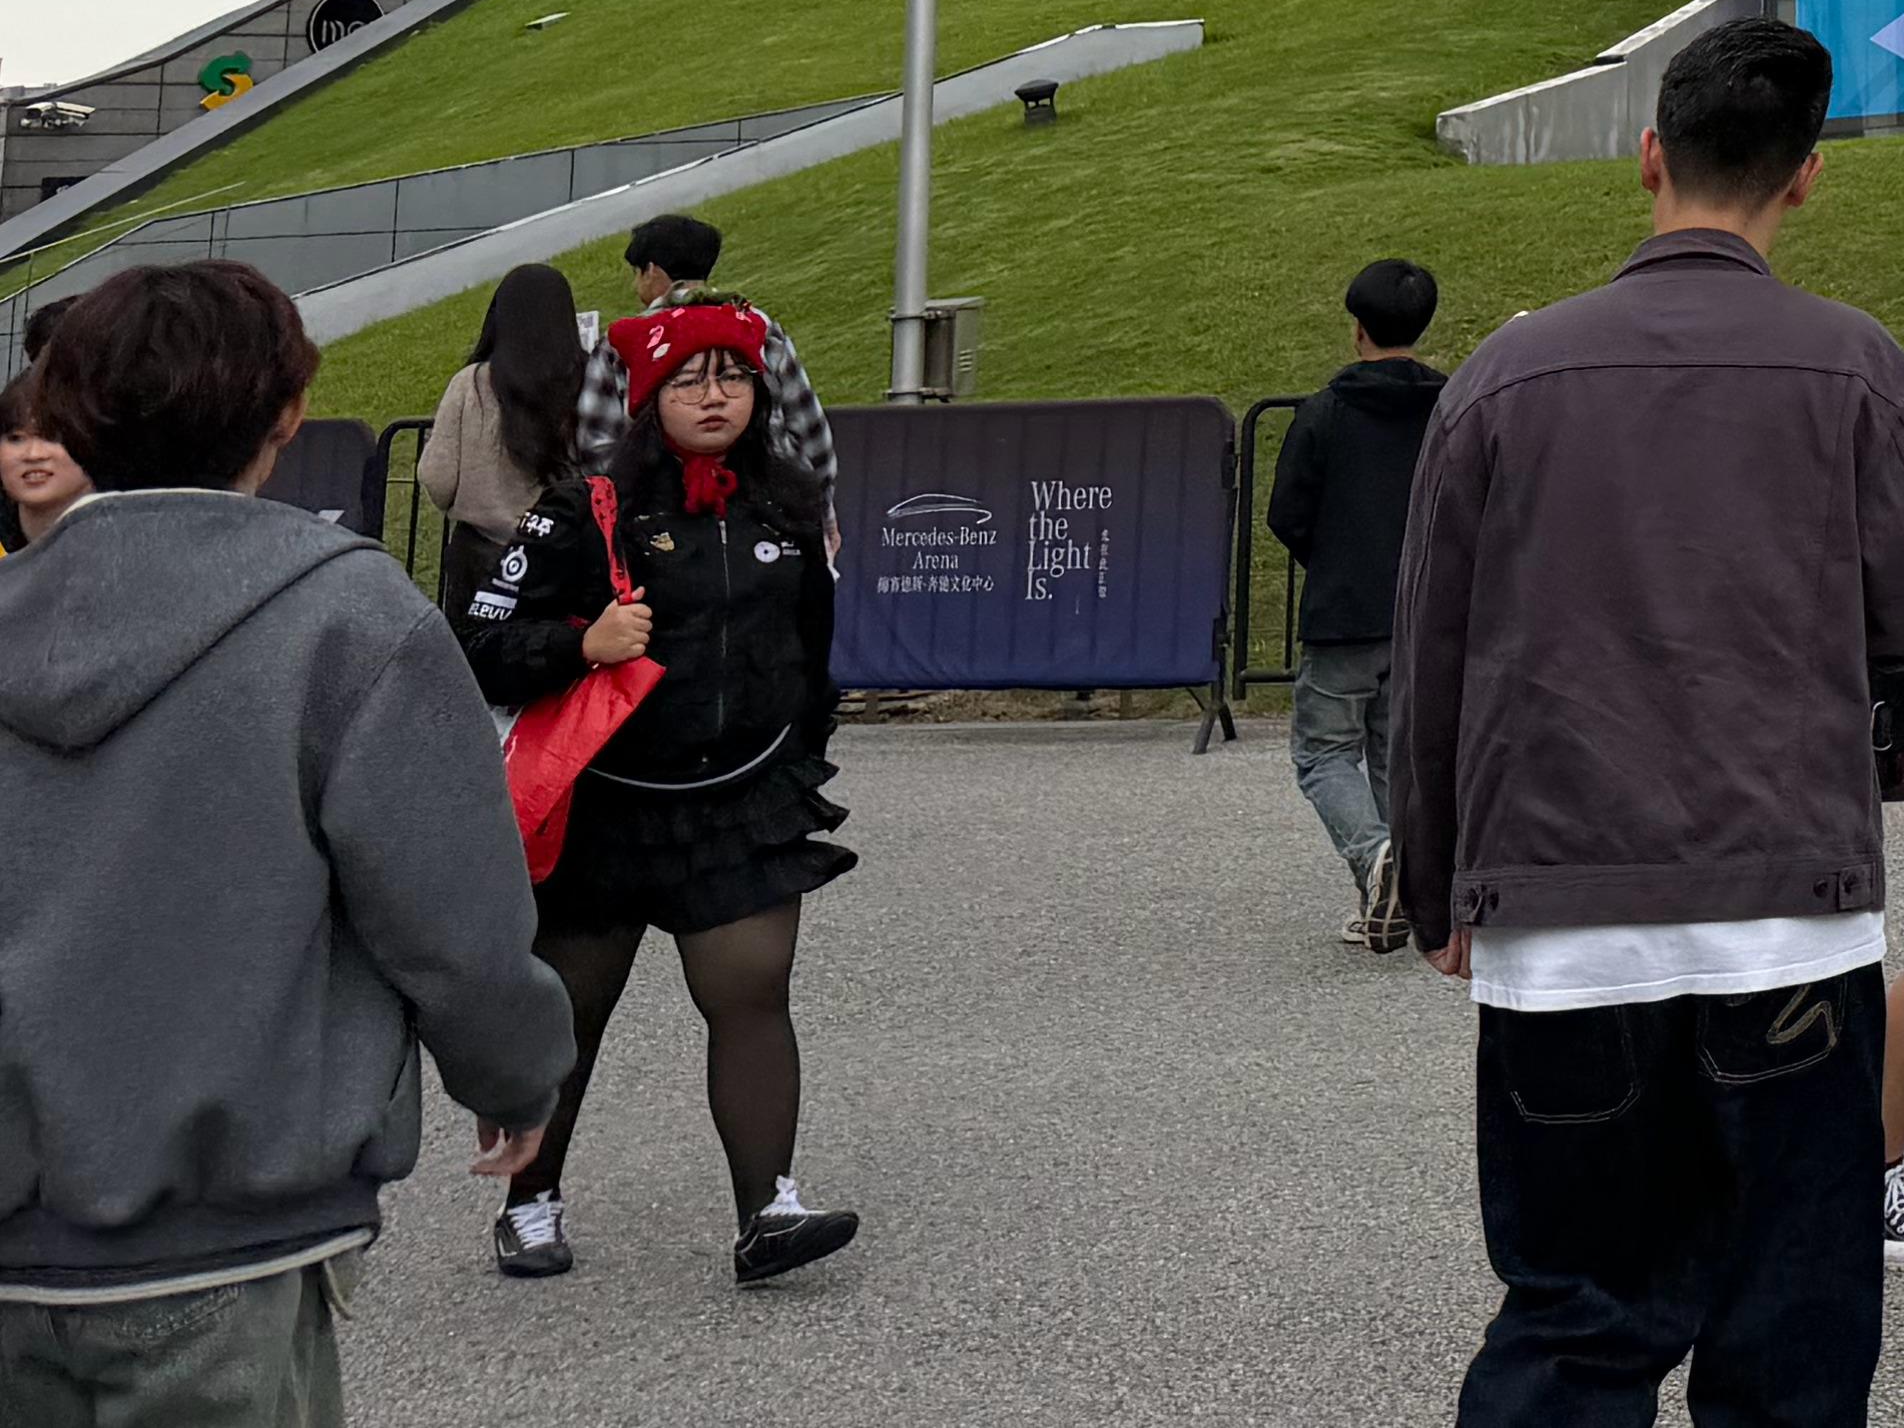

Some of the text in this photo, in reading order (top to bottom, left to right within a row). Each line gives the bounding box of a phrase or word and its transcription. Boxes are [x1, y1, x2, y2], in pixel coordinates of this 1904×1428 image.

[1031, 480, 1112, 511] Where
[881, 526, 997, 547] Mercedes-Benz
[1029, 510, 1068, 541] the
[912, 551, 959, 570] Arena
[1027, 539, 1092, 578] Light
[1025, 567, 1053, 600] Is.
